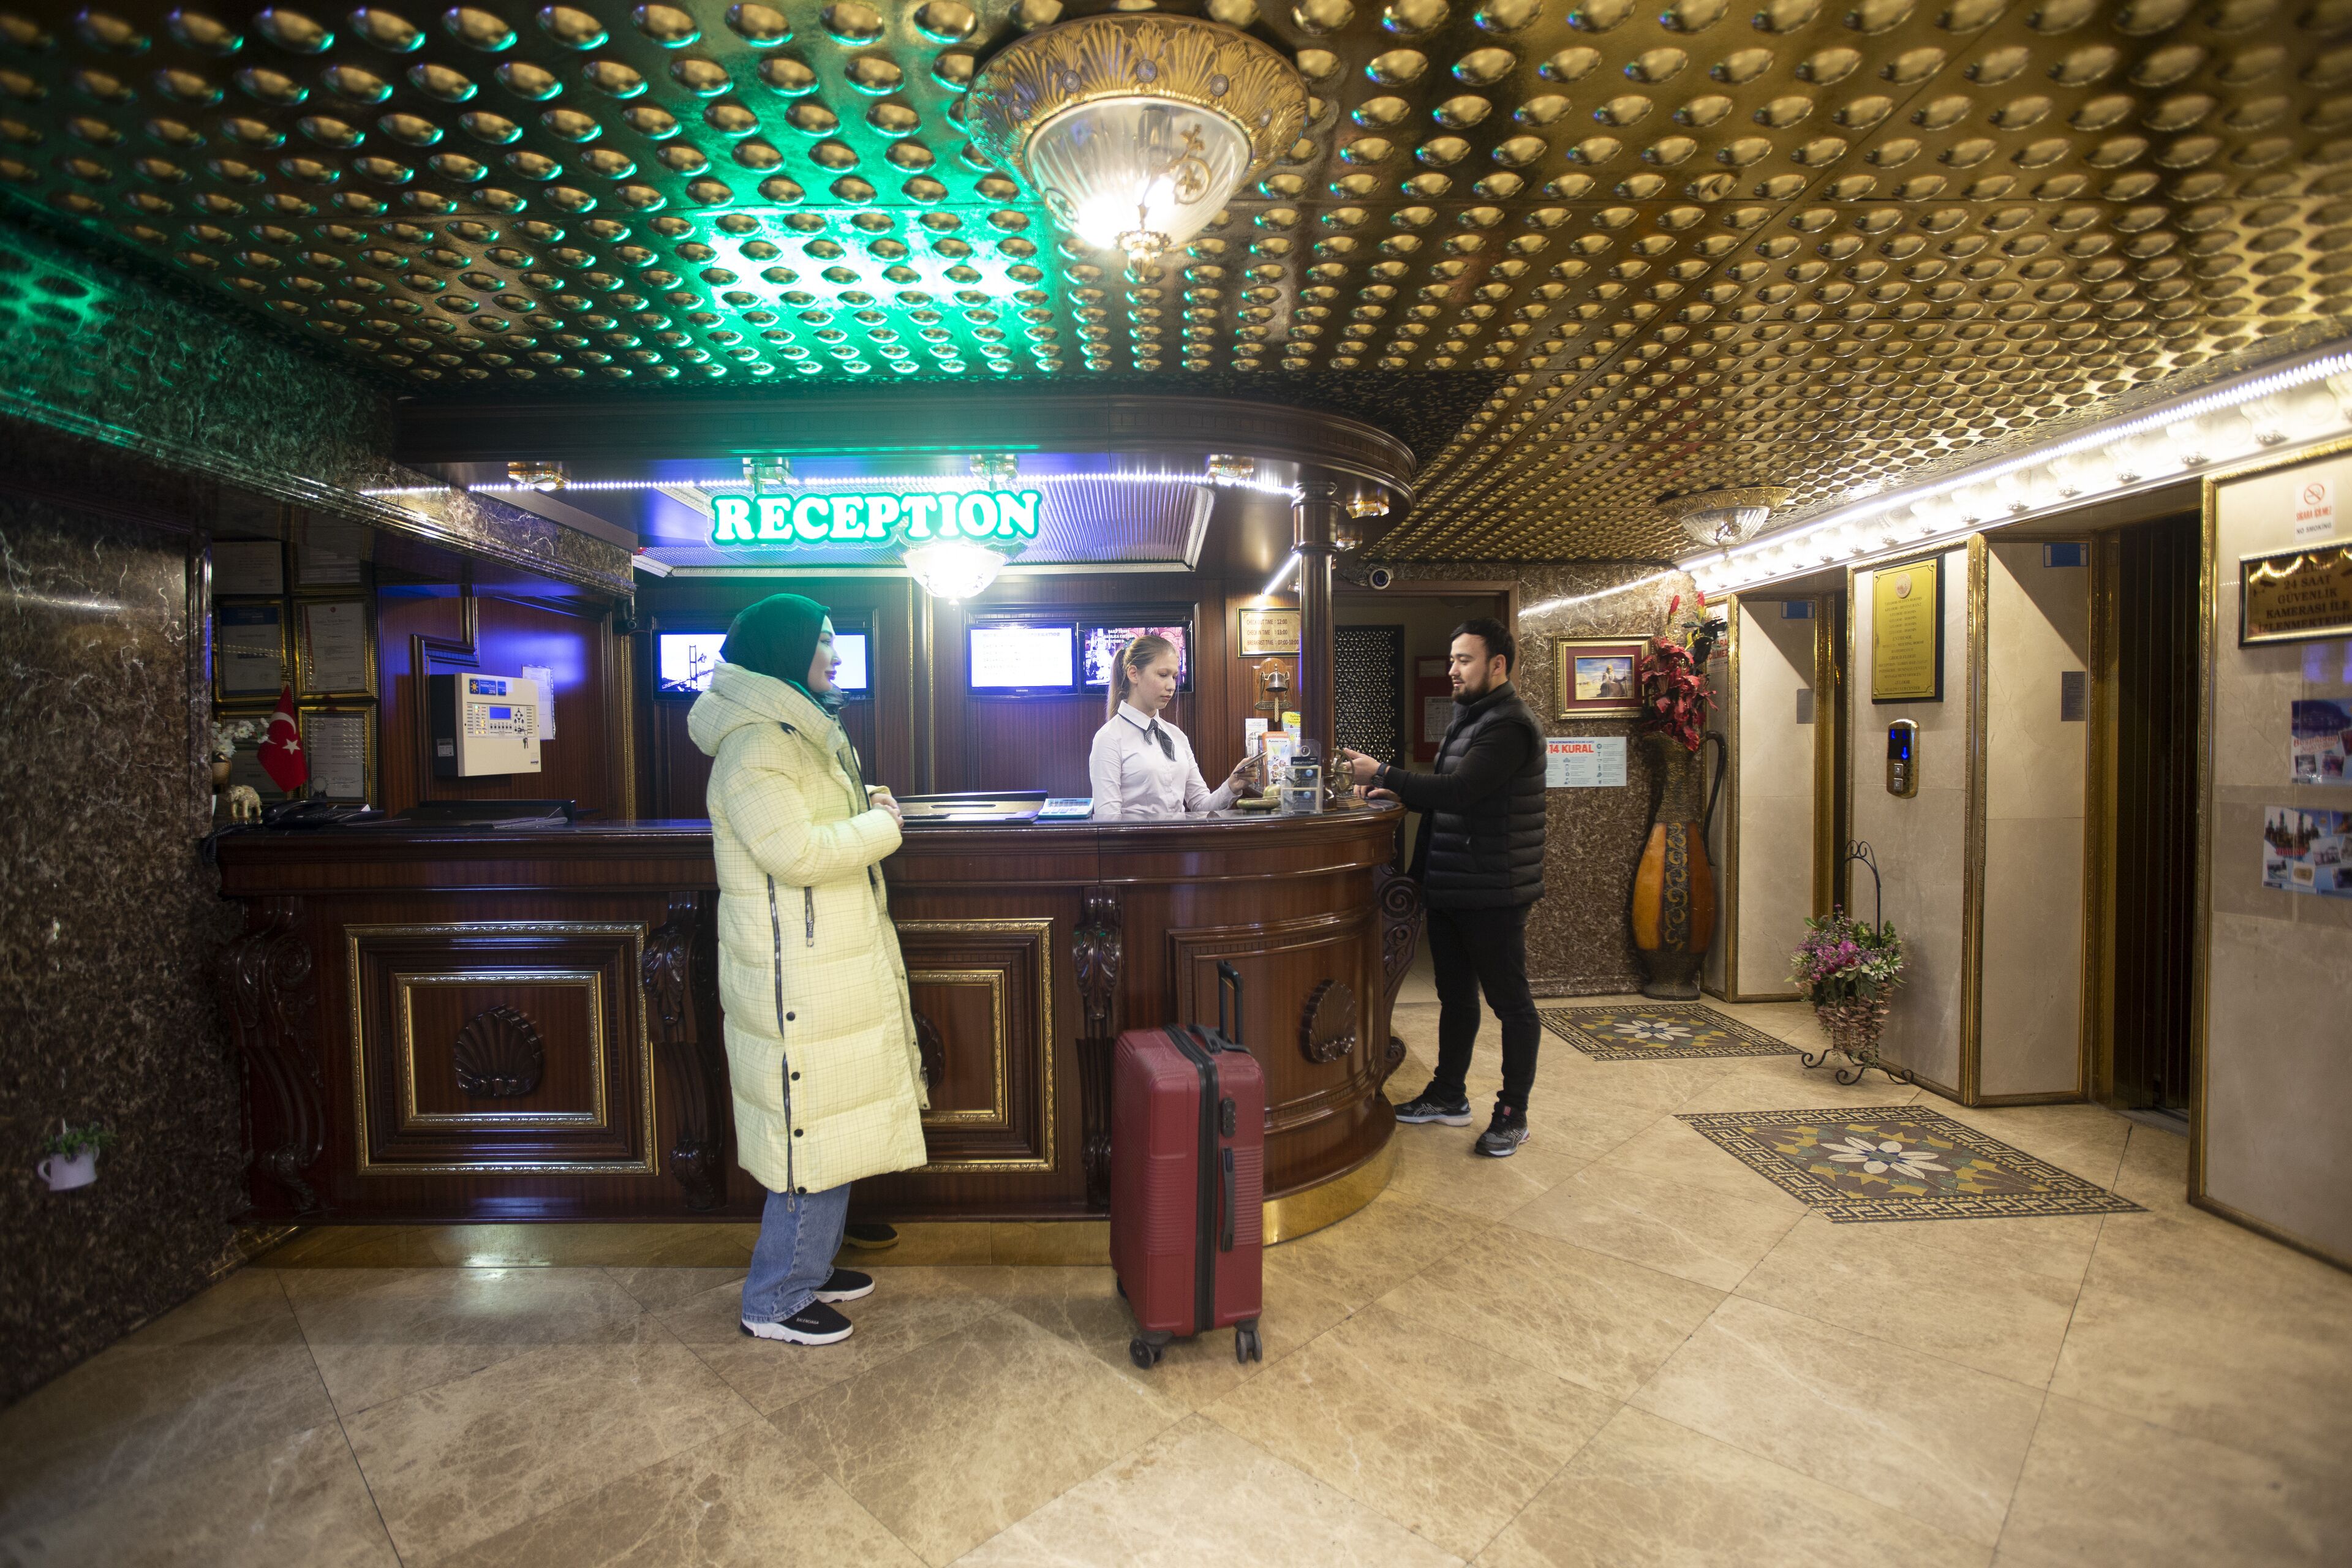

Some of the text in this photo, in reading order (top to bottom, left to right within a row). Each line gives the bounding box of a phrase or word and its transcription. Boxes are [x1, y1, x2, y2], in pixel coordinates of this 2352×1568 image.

[712, 491, 1041, 541] RECEPTION
[2283, 575, 2331, 590] 24 SAAT
[2277, 588, 2337, 604] GÜVENLİK
[2266, 603, 2326, 619] KAMERASI
[1549, 744, 1594, 753] 14 KURAL
